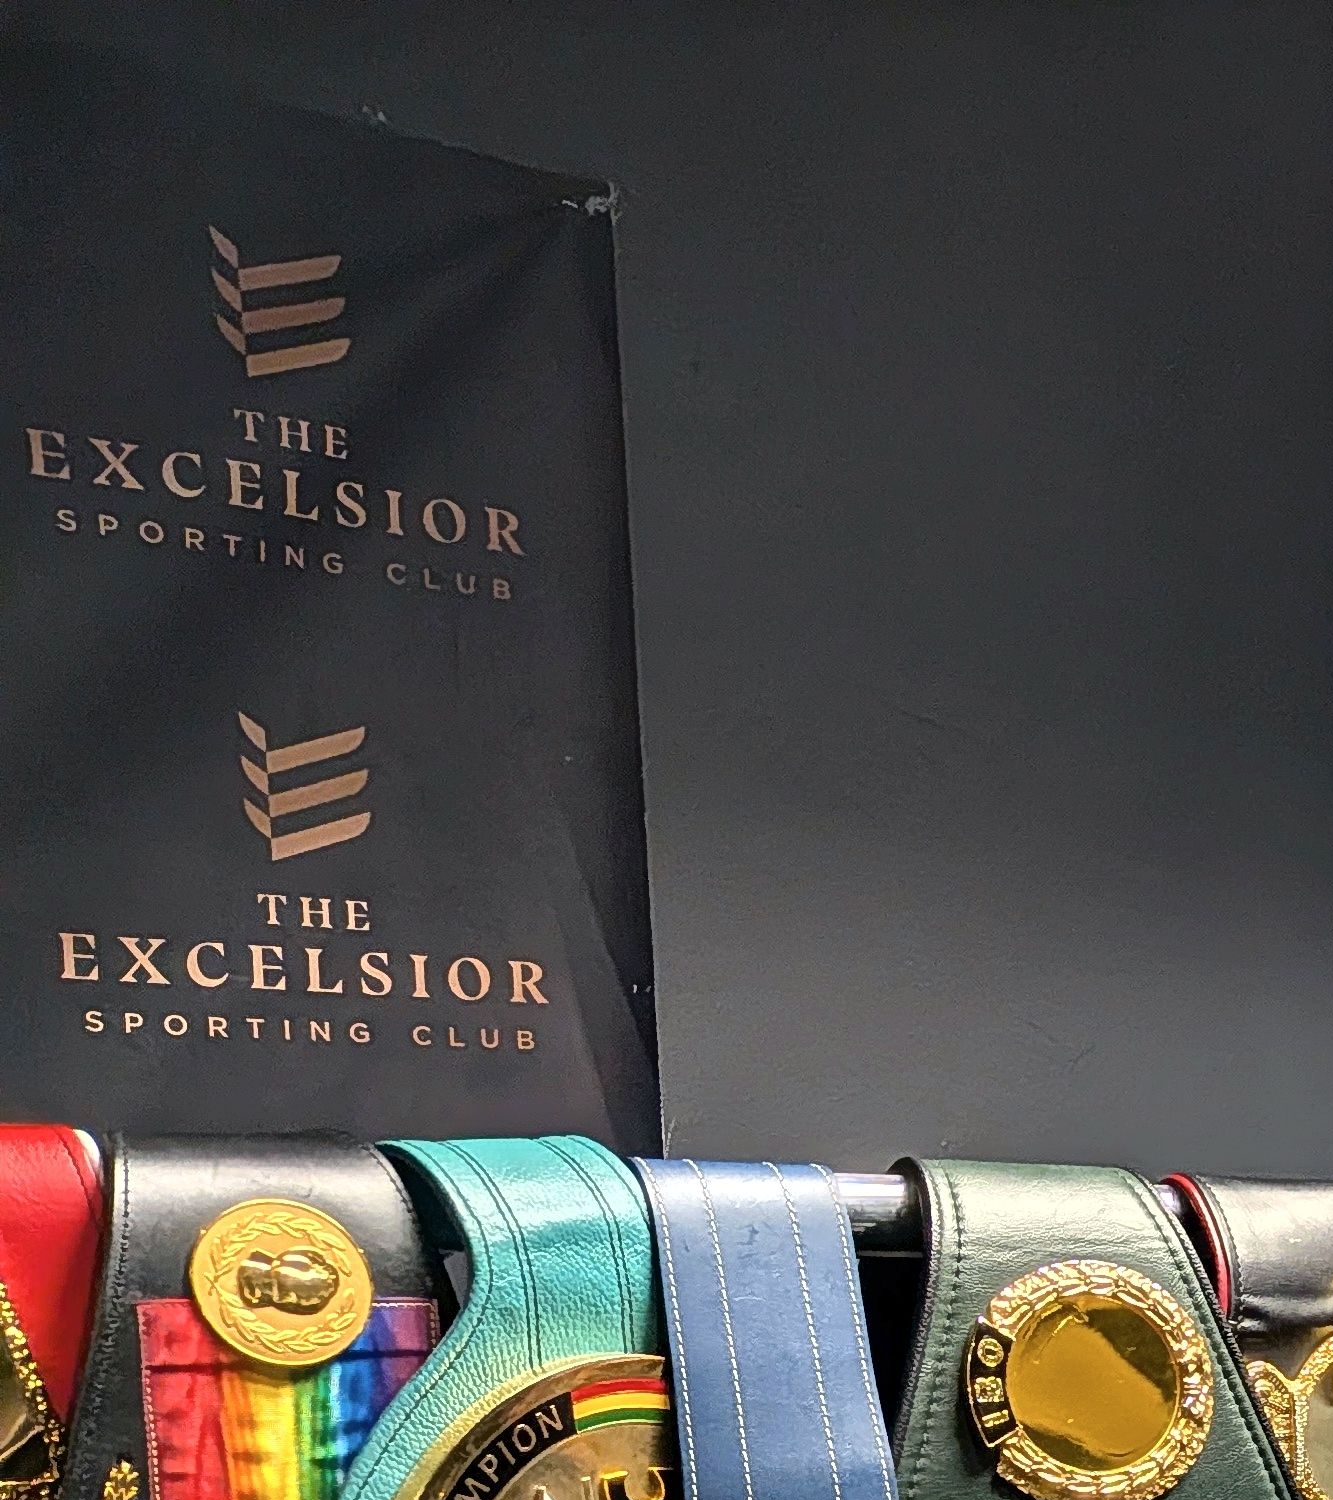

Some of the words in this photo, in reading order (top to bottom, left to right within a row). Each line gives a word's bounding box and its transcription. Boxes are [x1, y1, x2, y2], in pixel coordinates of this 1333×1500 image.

[233, 408, 349, 460] THE
[25, 427, 526, 557] EXCELSIOR
[54, 508, 345, 576] SPORTING
[386, 562, 513, 601] CLUB
[256, 893, 371, 932] THE
[57, 931, 551, 1006] EXCELSIOR
[83, 1010, 373, 1045] SPORTING
[412, 1024, 537, 1052] CLUB
